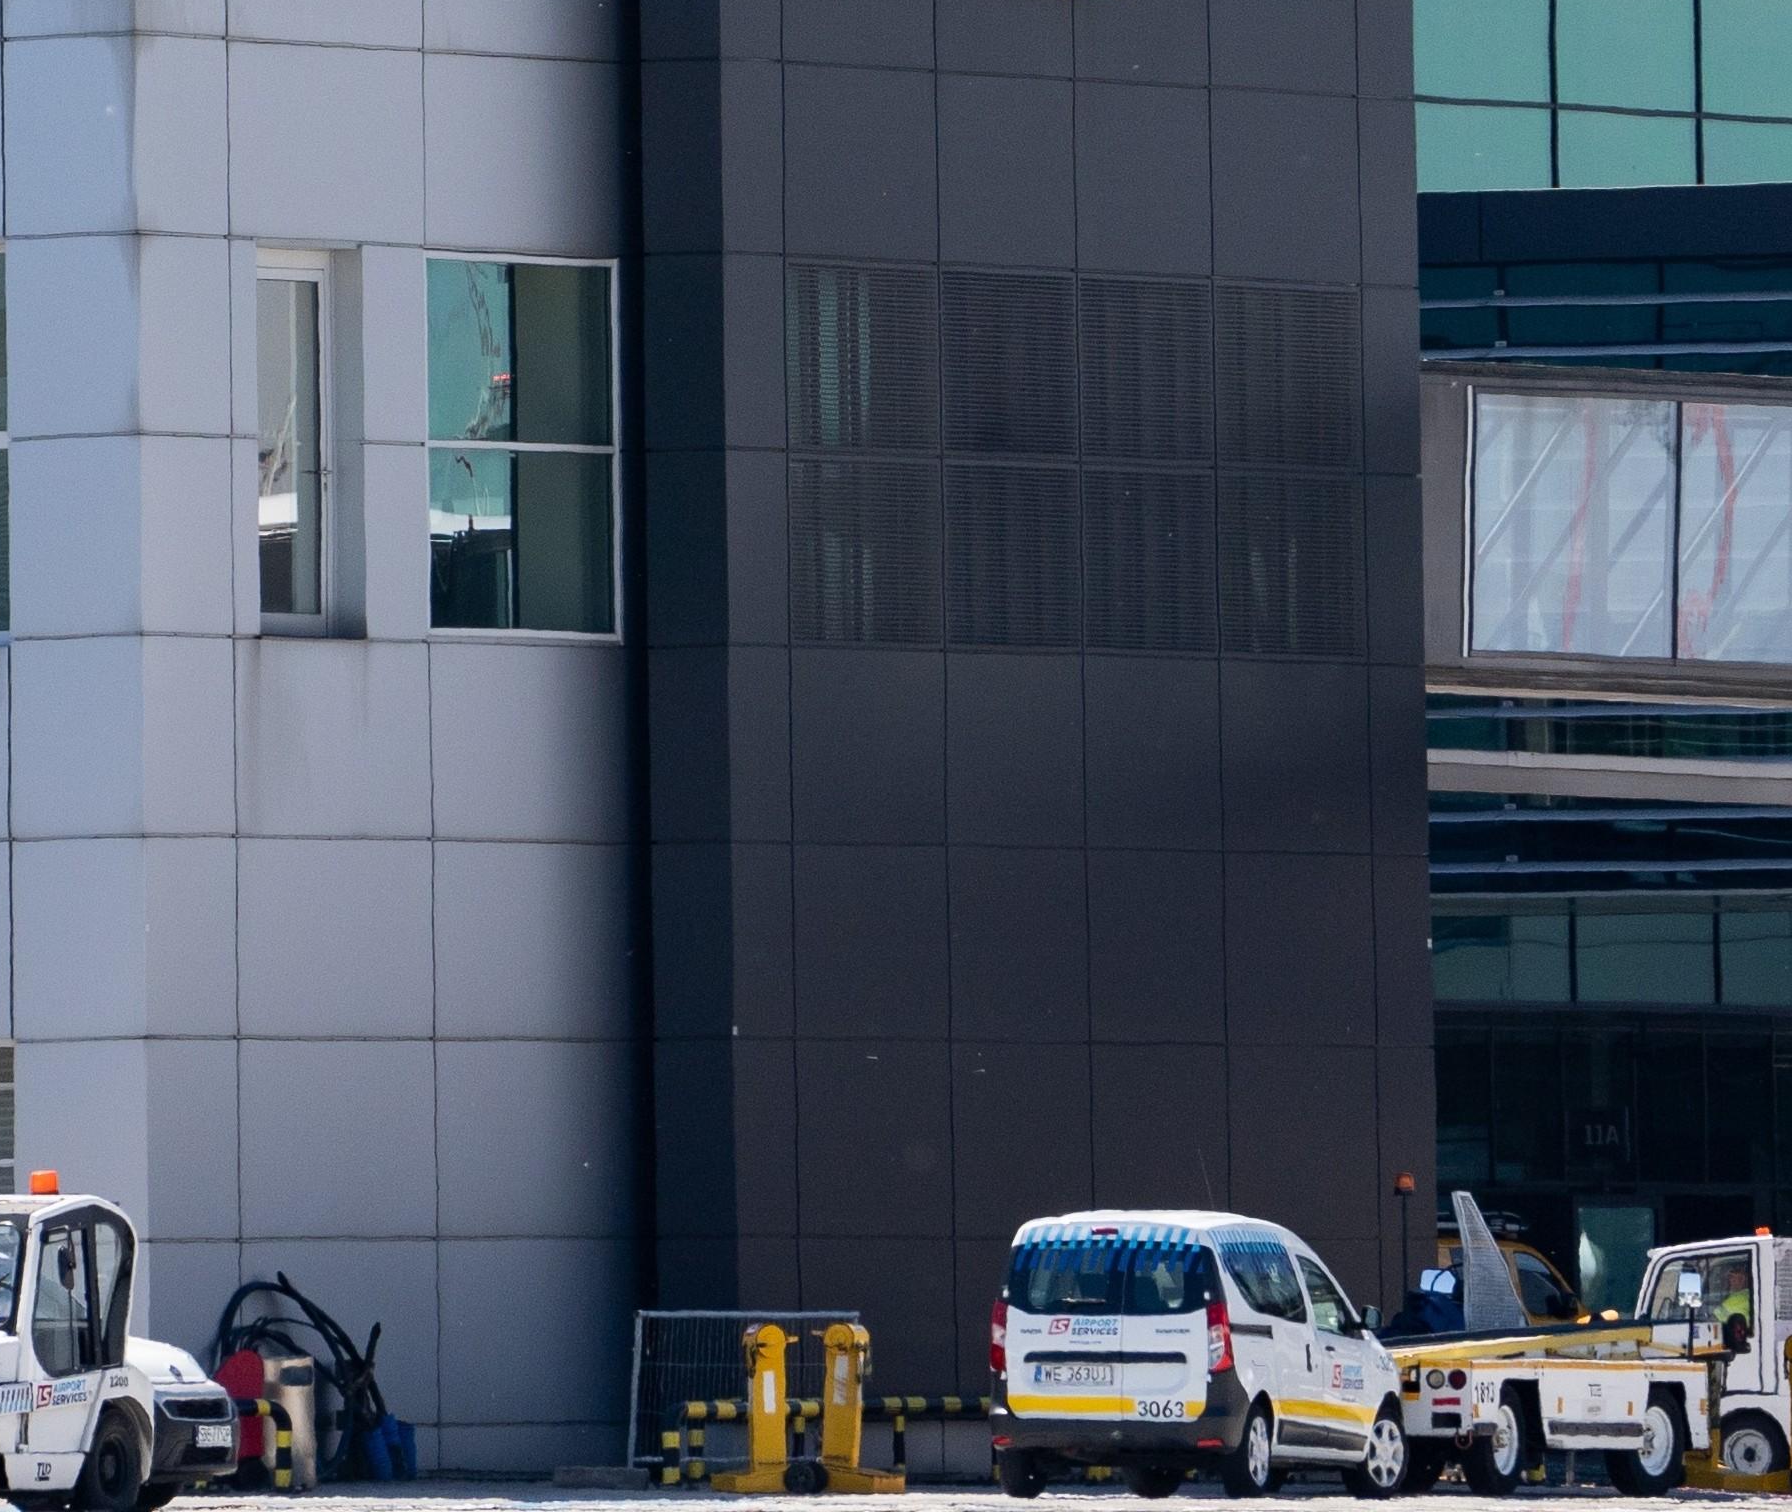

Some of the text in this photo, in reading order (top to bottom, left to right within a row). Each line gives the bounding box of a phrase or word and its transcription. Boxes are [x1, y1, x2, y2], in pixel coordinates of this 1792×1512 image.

[1584, 1124, 1619, 1145] 11A
[1050, 1319, 1070, 1334] LS
[1073, 1318, 1118, 1327] AIRPORT
[1071, 1327, 1118, 1336] SERVICES
[1044, 1366, 1062, 1382] WE
[53, 1379, 86, 1392] AIRPORT
[38, 1386, 52, 1406] LS
[52, 1392, 87, 1406] SERVICES
[1137, 1400, 1185, 1418] 3063
